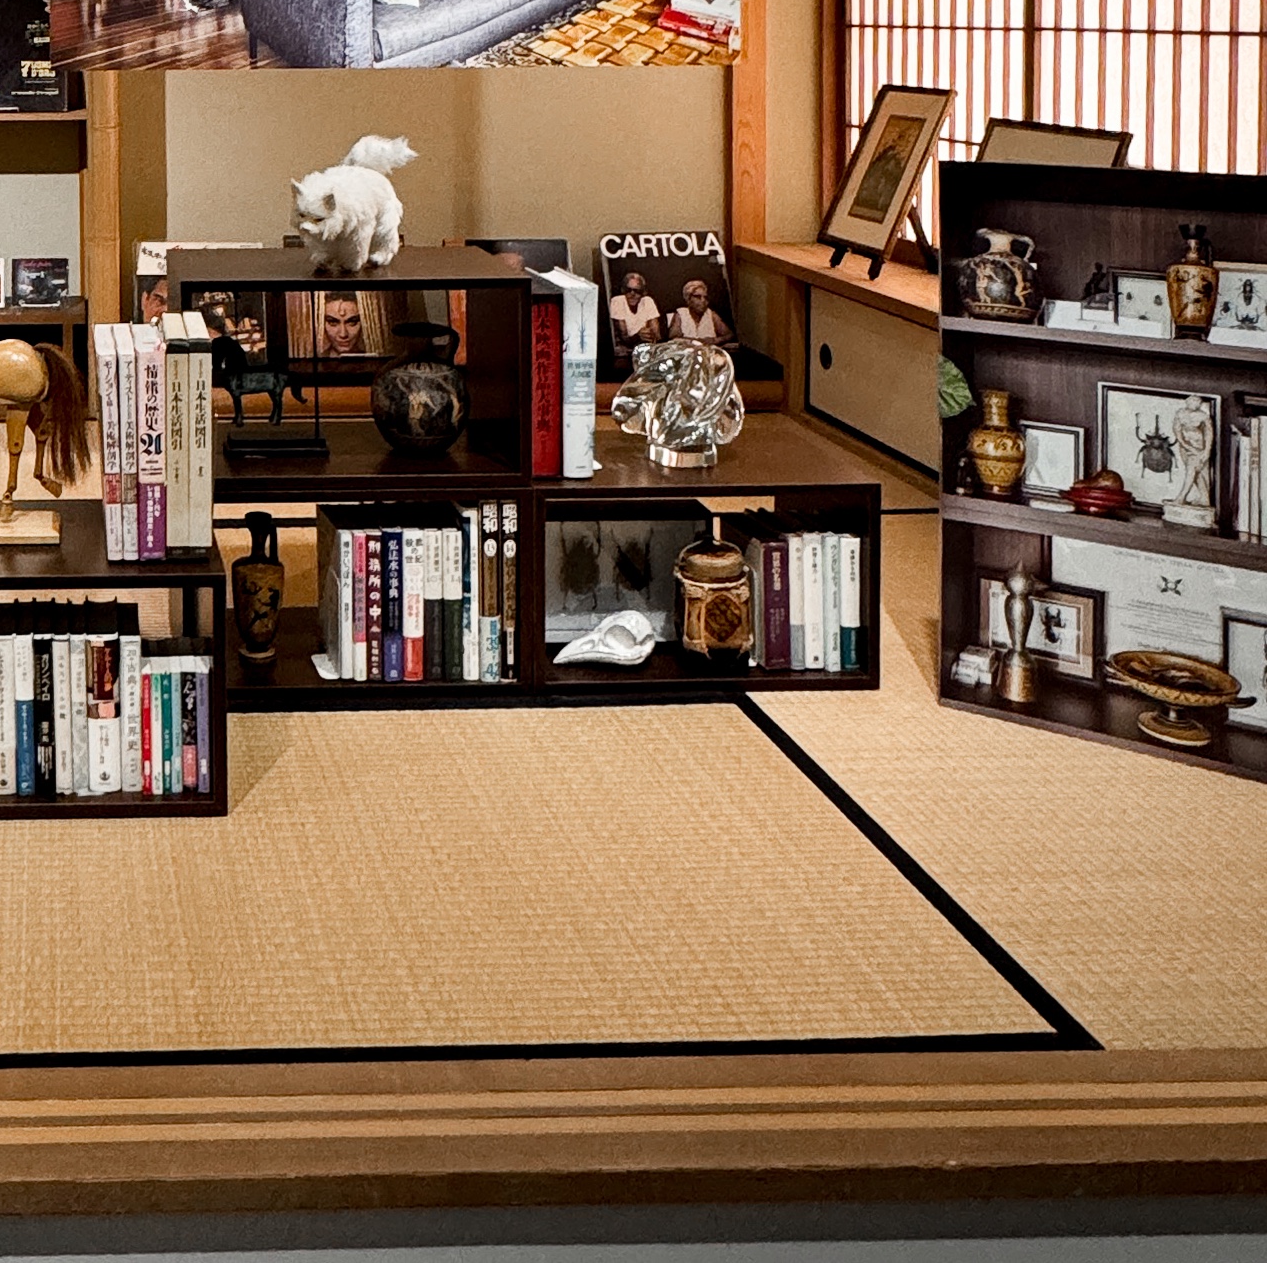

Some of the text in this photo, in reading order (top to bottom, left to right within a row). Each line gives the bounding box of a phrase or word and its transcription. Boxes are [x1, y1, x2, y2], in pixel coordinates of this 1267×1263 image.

[600, 232, 724, 258] CARTOLA
[483, 504, 498, 533] 昭和
[502, 504, 517, 533] 昭和
